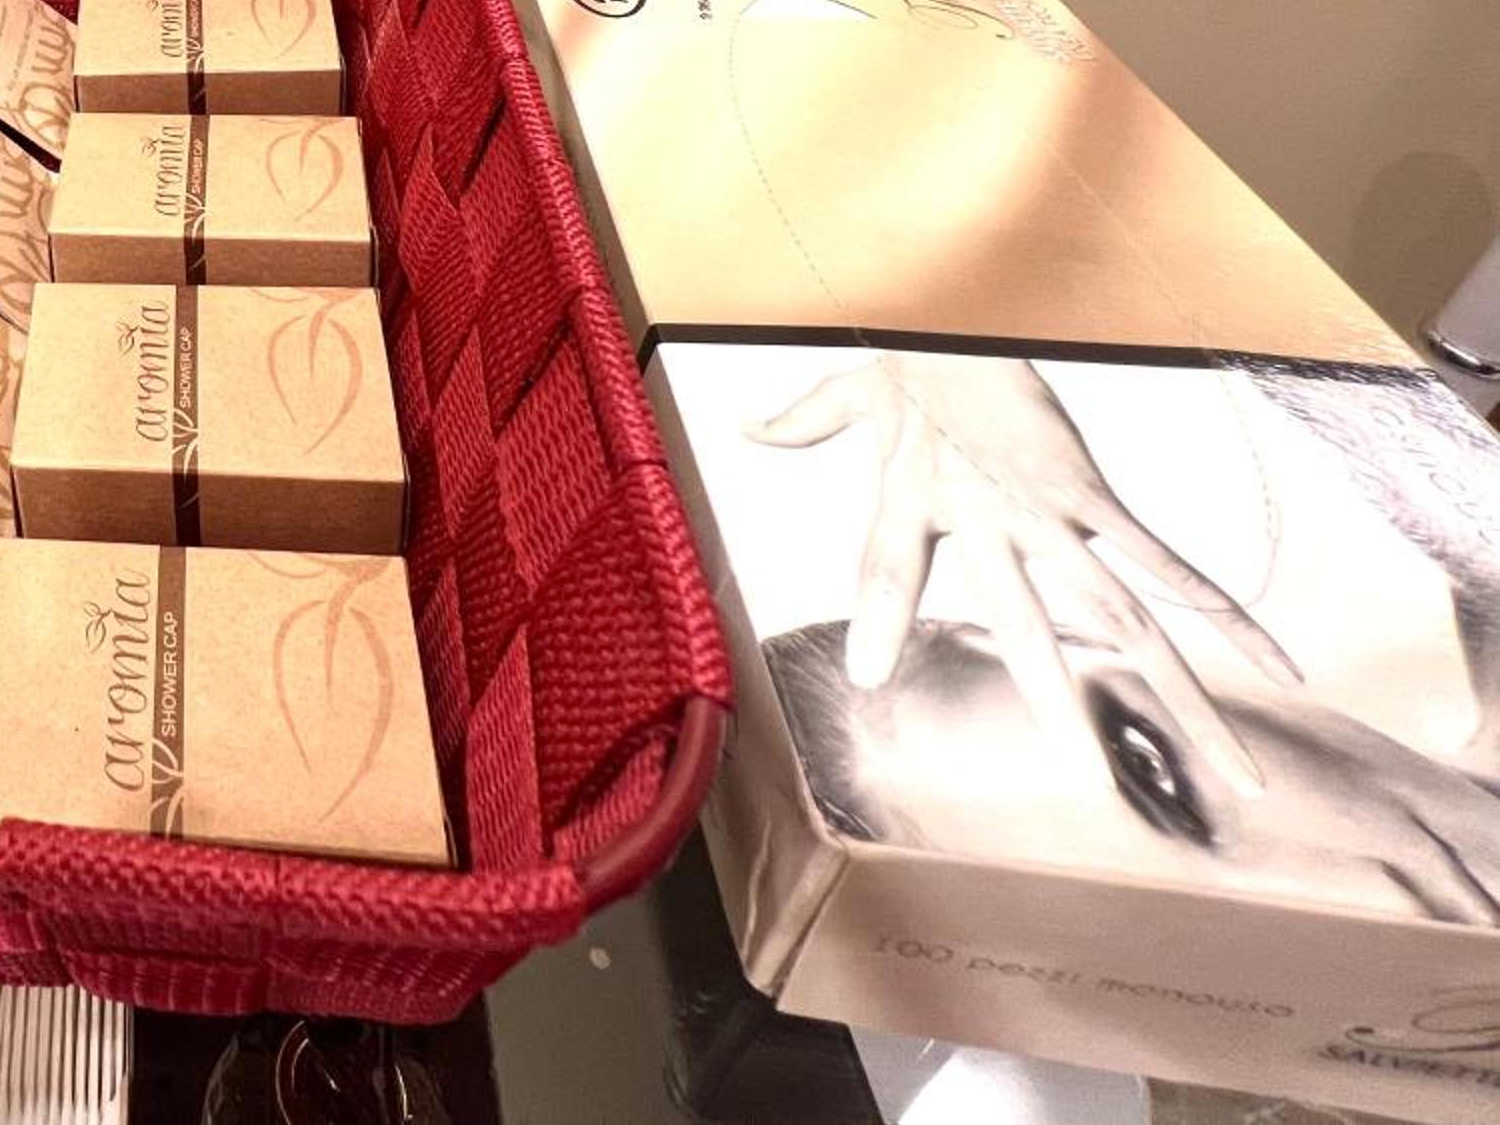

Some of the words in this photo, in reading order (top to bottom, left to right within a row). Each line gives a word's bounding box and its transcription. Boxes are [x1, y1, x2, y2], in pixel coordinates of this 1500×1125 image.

[153, 126, 187, 217] aromia
[134, 298, 171, 444] aromia
[178, 355, 192, 410] SHOWER
[181, 325, 193, 353] CAP
[163, 609, 180, 649] CAP
[104, 569, 152, 793] aromia
[161, 651, 179, 738] SHOWER
